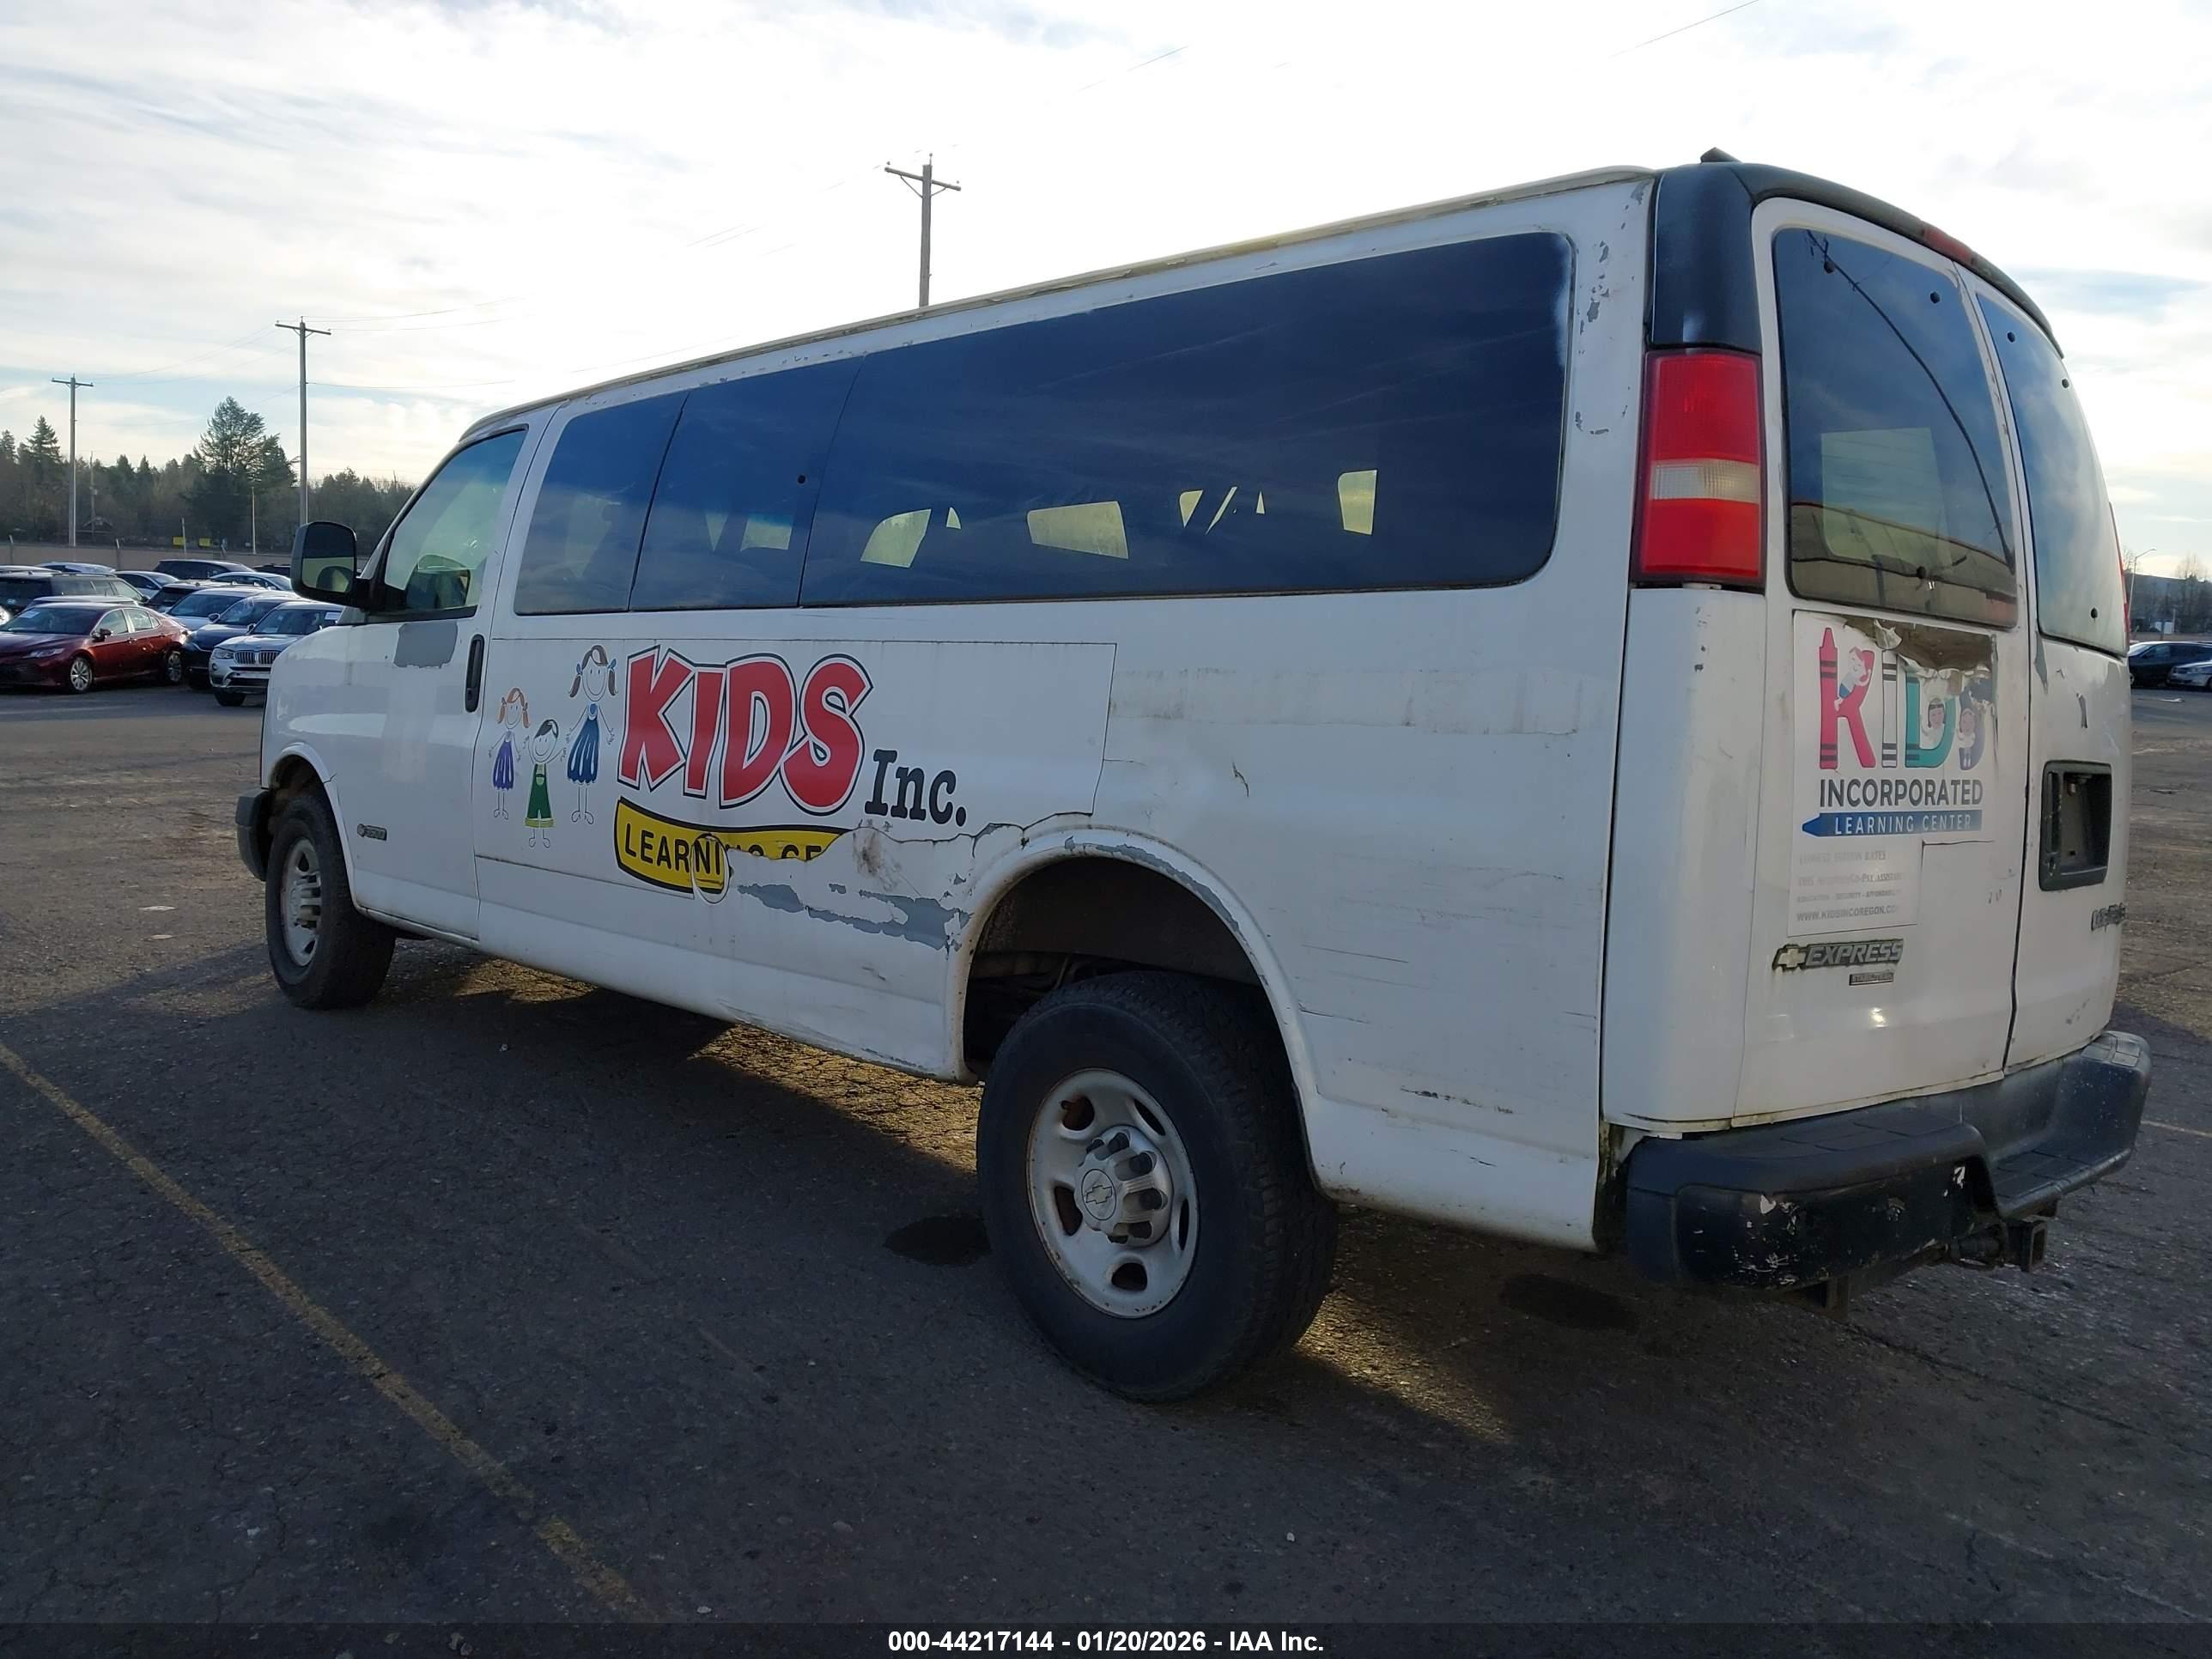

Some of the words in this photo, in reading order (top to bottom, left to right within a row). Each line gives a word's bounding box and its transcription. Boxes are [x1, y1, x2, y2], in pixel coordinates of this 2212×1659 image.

[617, 645, 874, 817] KIDS
[865, 749, 967, 827] Inc.
[1820, 778, 1984, 808] INCORPORATED
[1835, 815, 1914, 835] LEARNING
[1923, 813, 1971, 831] CENTER
[1805, 940, 1904, 966] EXPRESS
